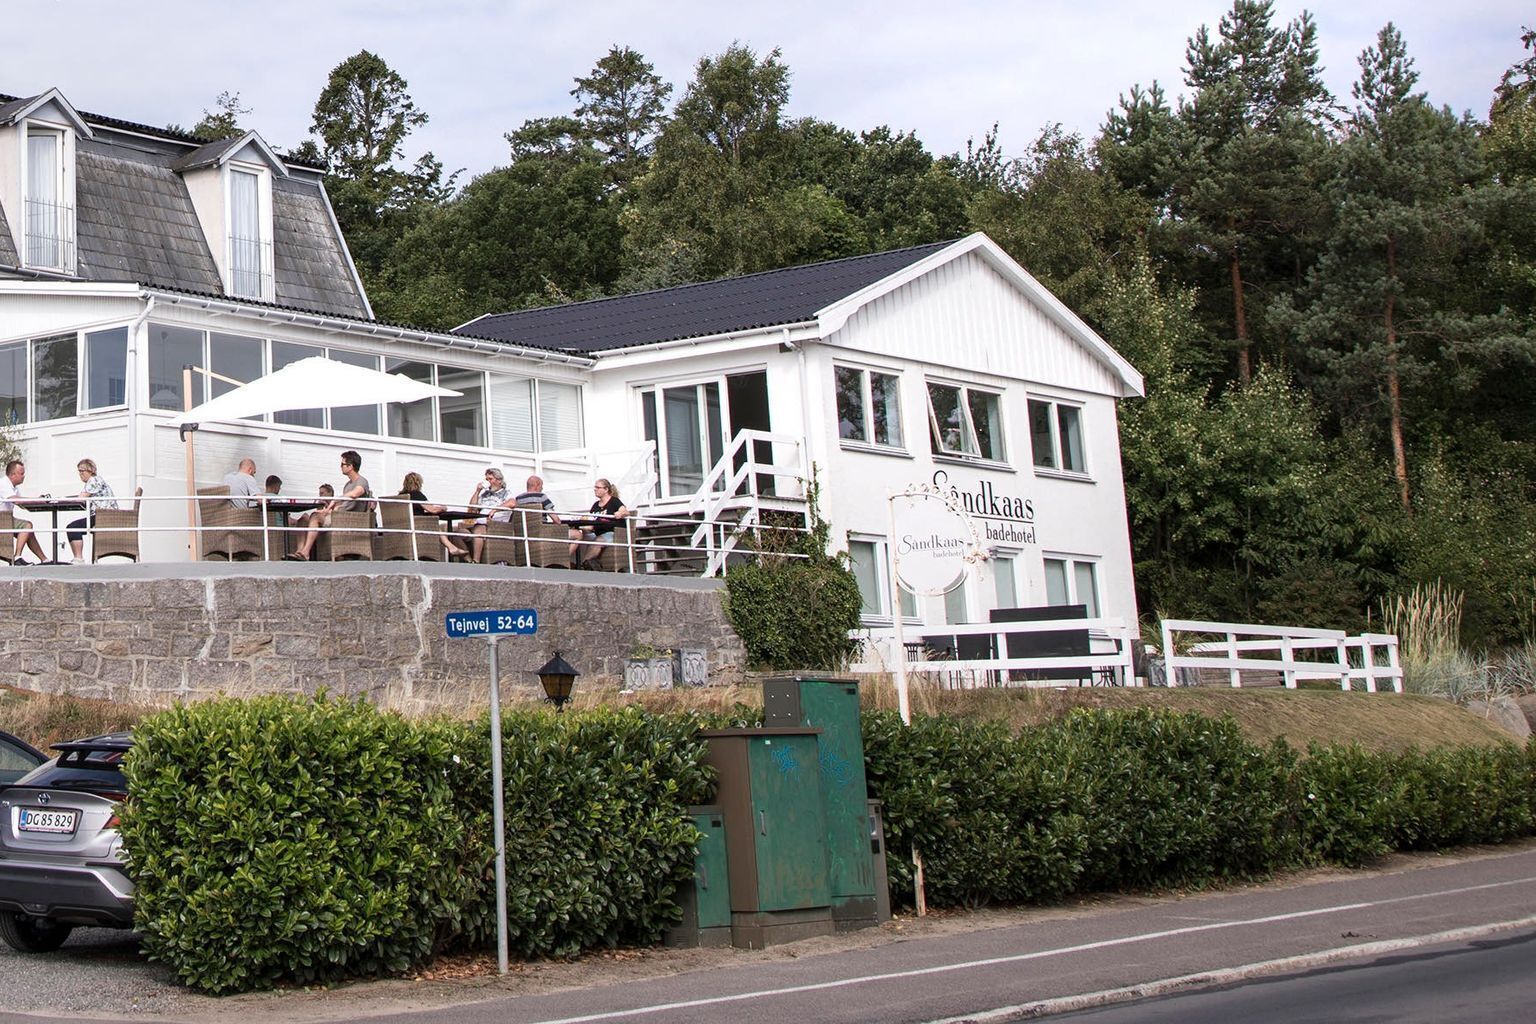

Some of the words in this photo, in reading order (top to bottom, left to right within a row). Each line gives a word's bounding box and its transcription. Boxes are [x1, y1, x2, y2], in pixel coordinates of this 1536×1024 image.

[985, 522, 1037, 544] badehotel
[449, 617, 489, 633] Tejnvej
[497, 615, 534, 630] 52-64
[26, 813, 40, 826] DG
[41, 813, 53, 826] 85
[55, 814, 73, 828] 829
